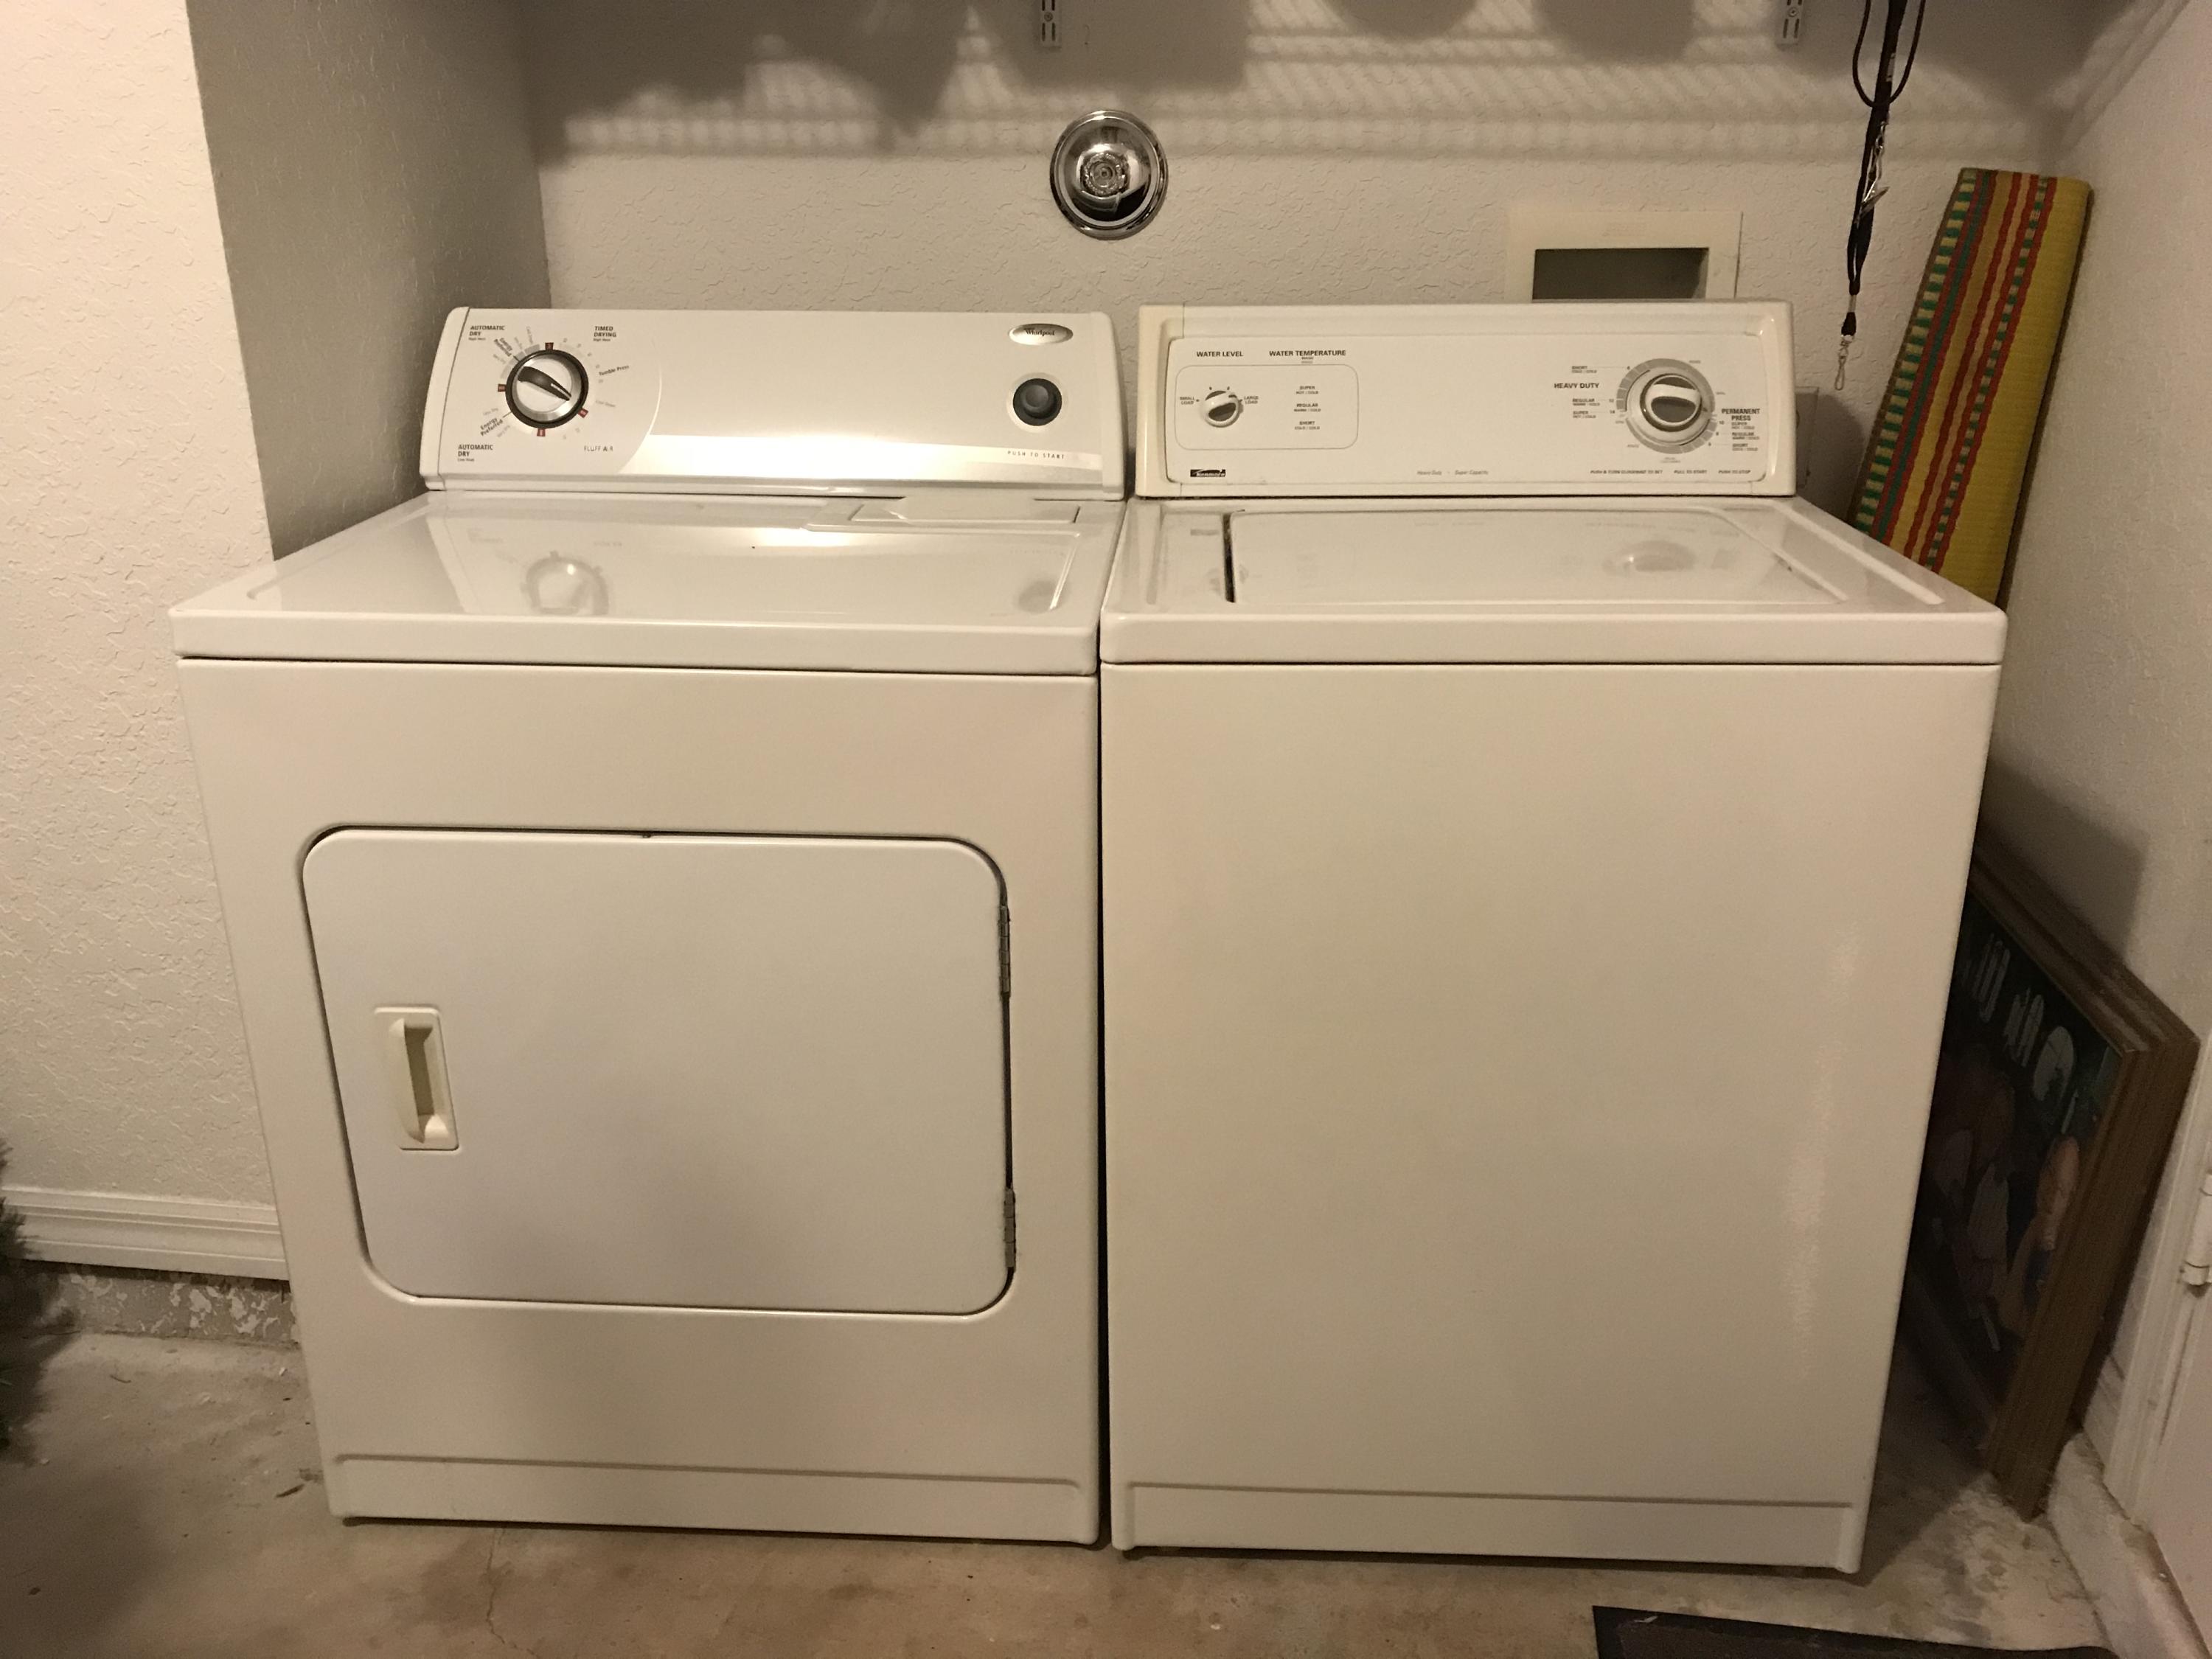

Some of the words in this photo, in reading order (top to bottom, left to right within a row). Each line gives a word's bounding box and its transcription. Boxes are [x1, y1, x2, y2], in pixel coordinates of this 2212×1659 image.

[1026, 328, 1055, 336] Whirlpool
[480, 418, 498, 430] Energy
[480, 419, 503, 437] Preferred
